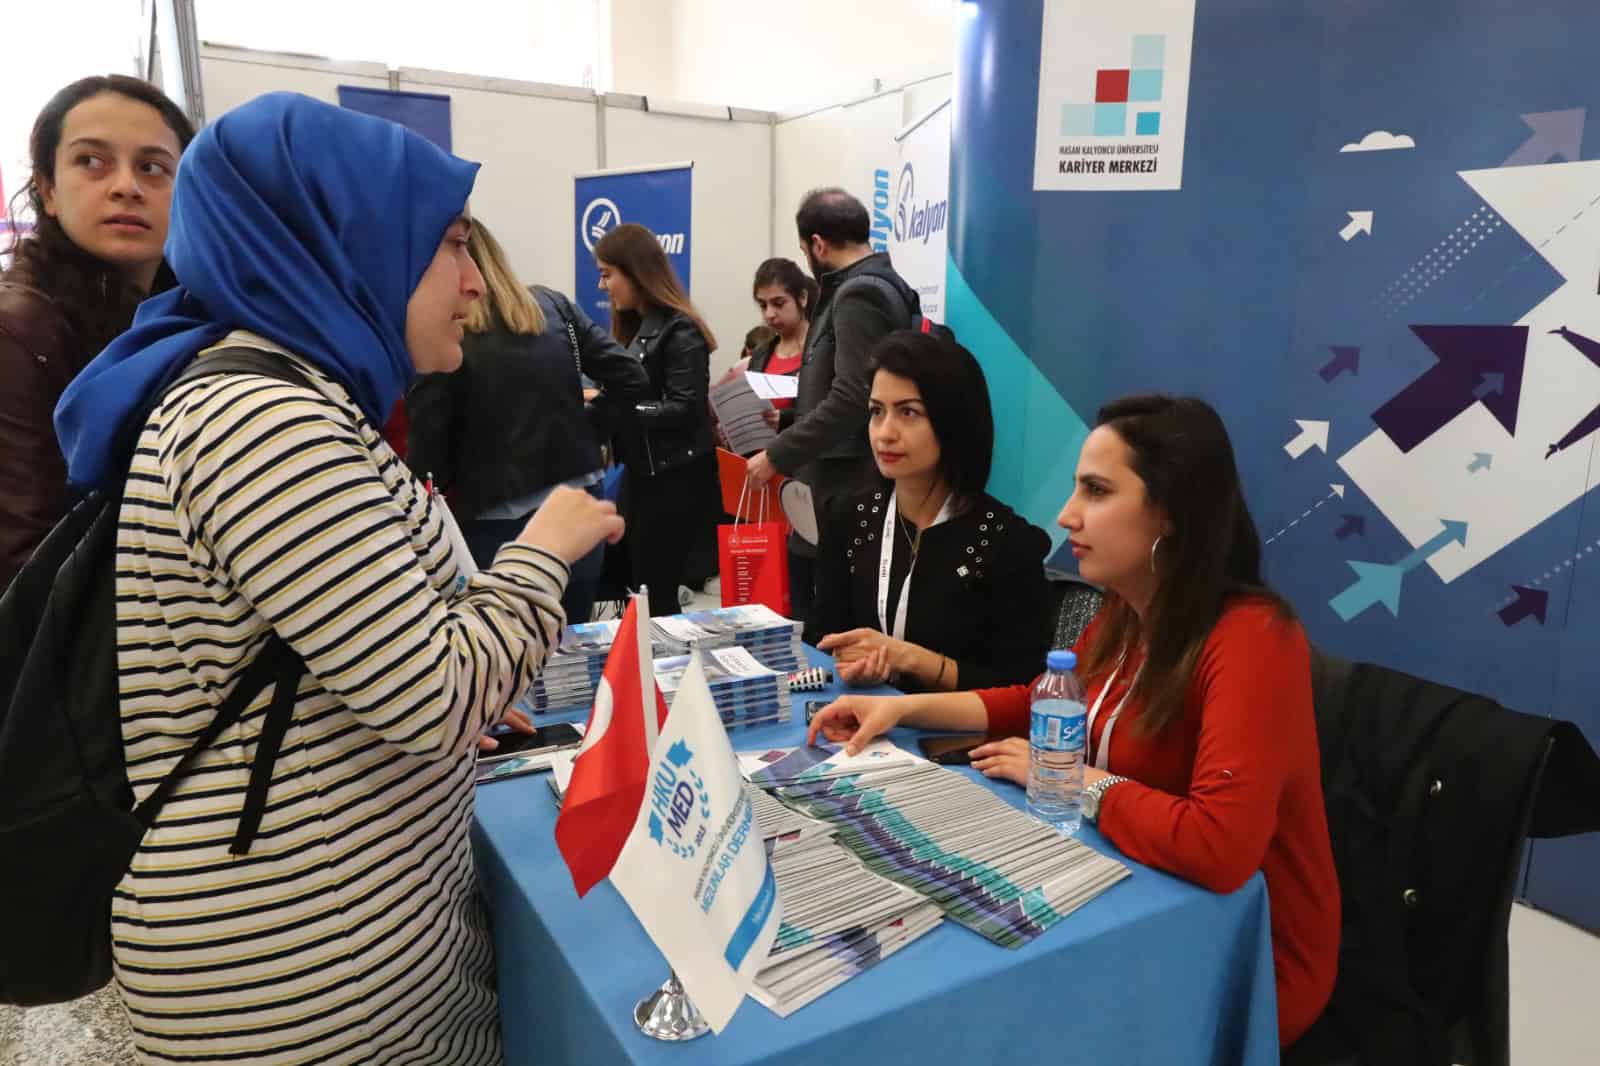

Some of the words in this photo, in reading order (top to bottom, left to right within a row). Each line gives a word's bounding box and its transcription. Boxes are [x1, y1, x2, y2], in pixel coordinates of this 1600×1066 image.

[1059, 143, 1080, 155] HASAN
[1082, 144, 1116, 155] KALYONCU
[1059, 158, 1105, 174] KARİYER
[1109, 156, 1158, 174] MERKEZİ
[870, 168, 892, 253] alyon
[909, 199, 947, 245] kalyon
[652, 761, 676, 817] HKU
[667, 781, 694, 838] MED
